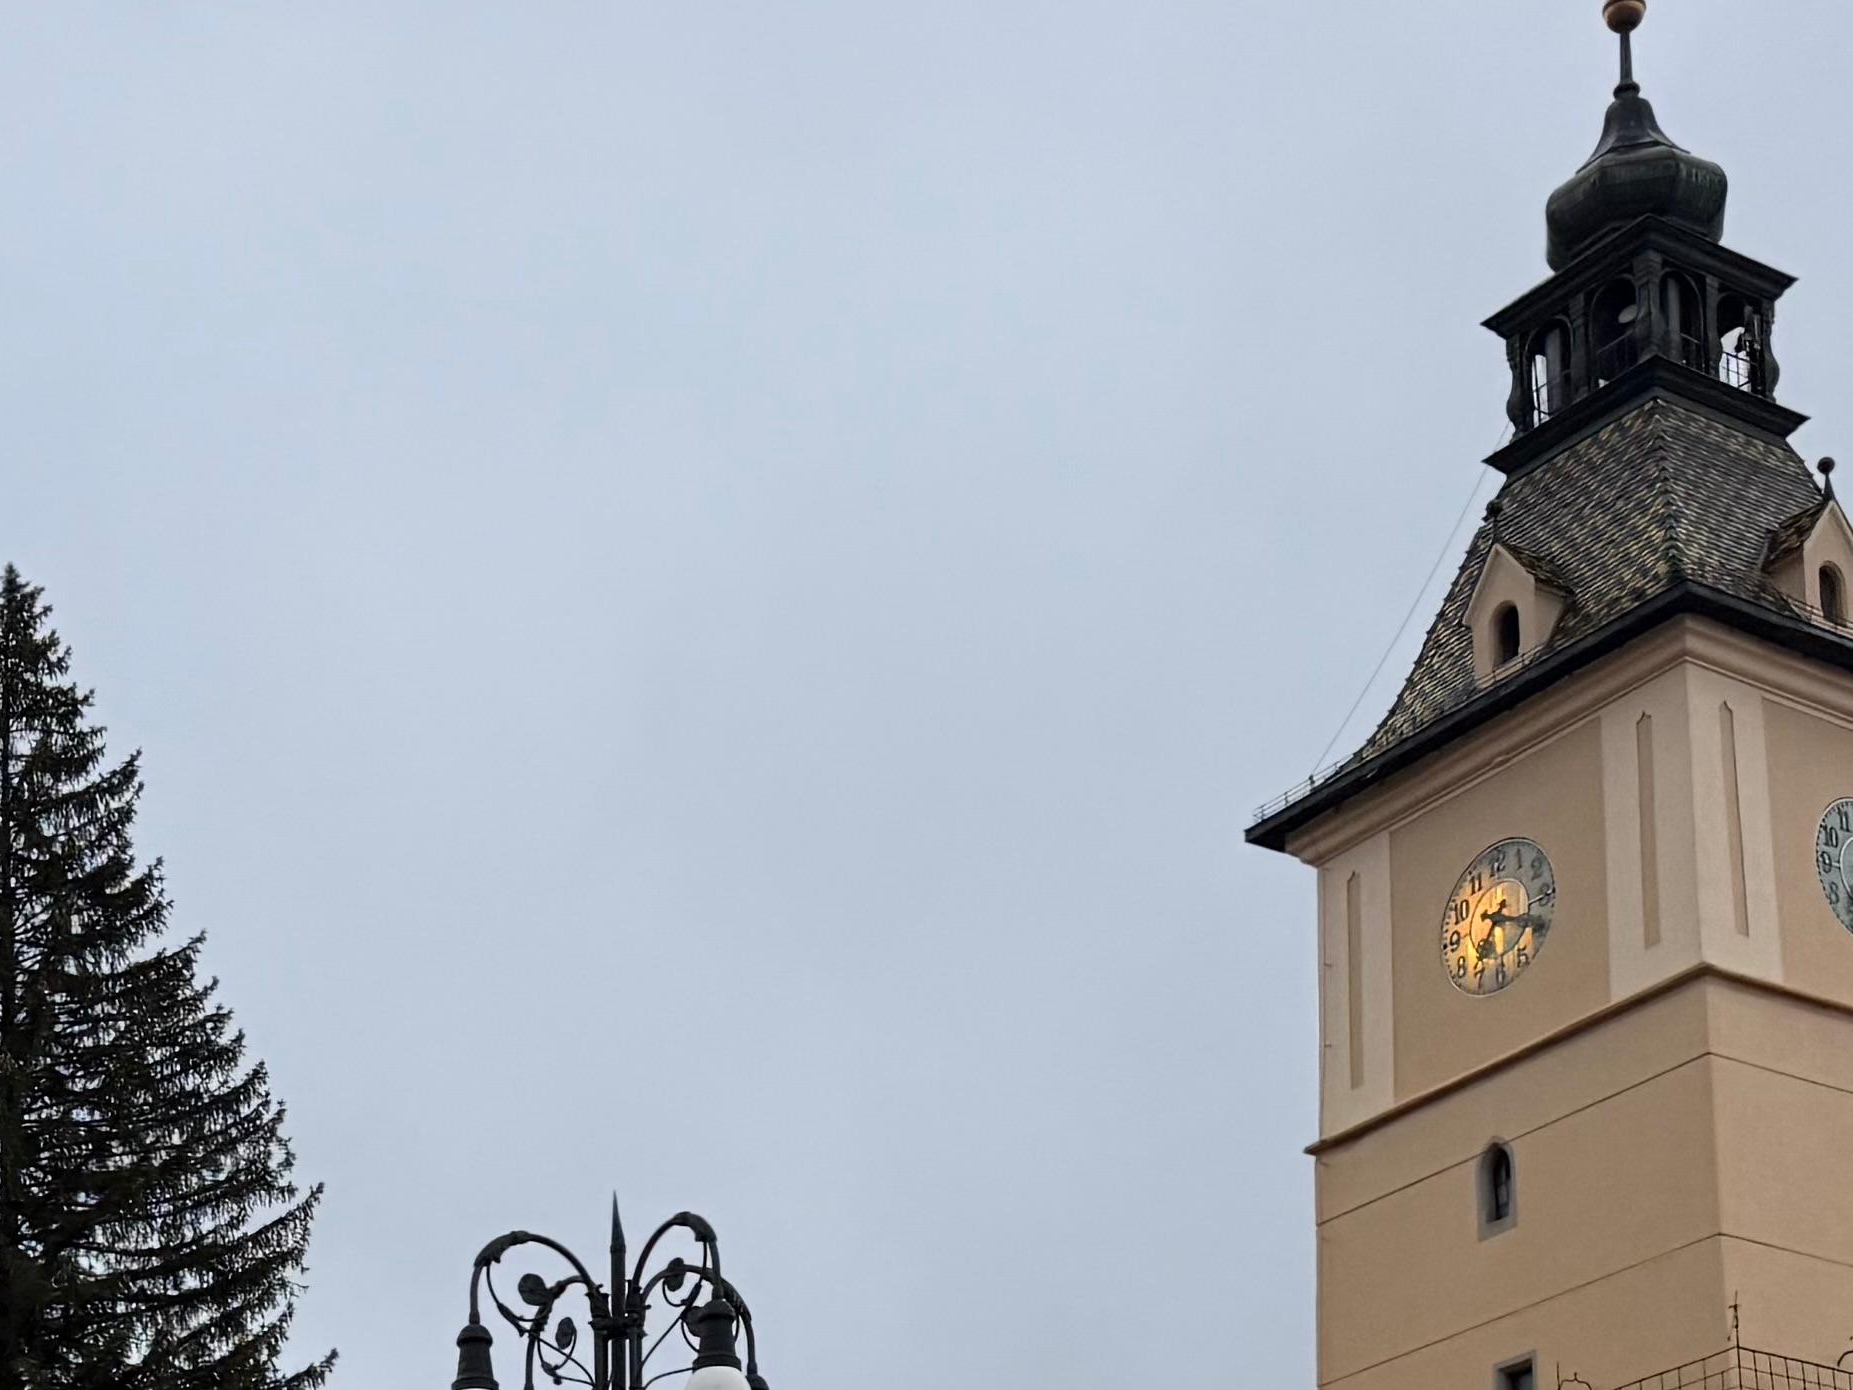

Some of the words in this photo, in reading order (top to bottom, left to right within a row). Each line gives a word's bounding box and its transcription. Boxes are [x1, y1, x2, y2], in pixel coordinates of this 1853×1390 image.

[1470, 872, 1483, 896] 11
[1452, 900, 1469, 925] 10
[1450, 931, 1460, 953] 9
[1457, 956, 1466, 978] 8
